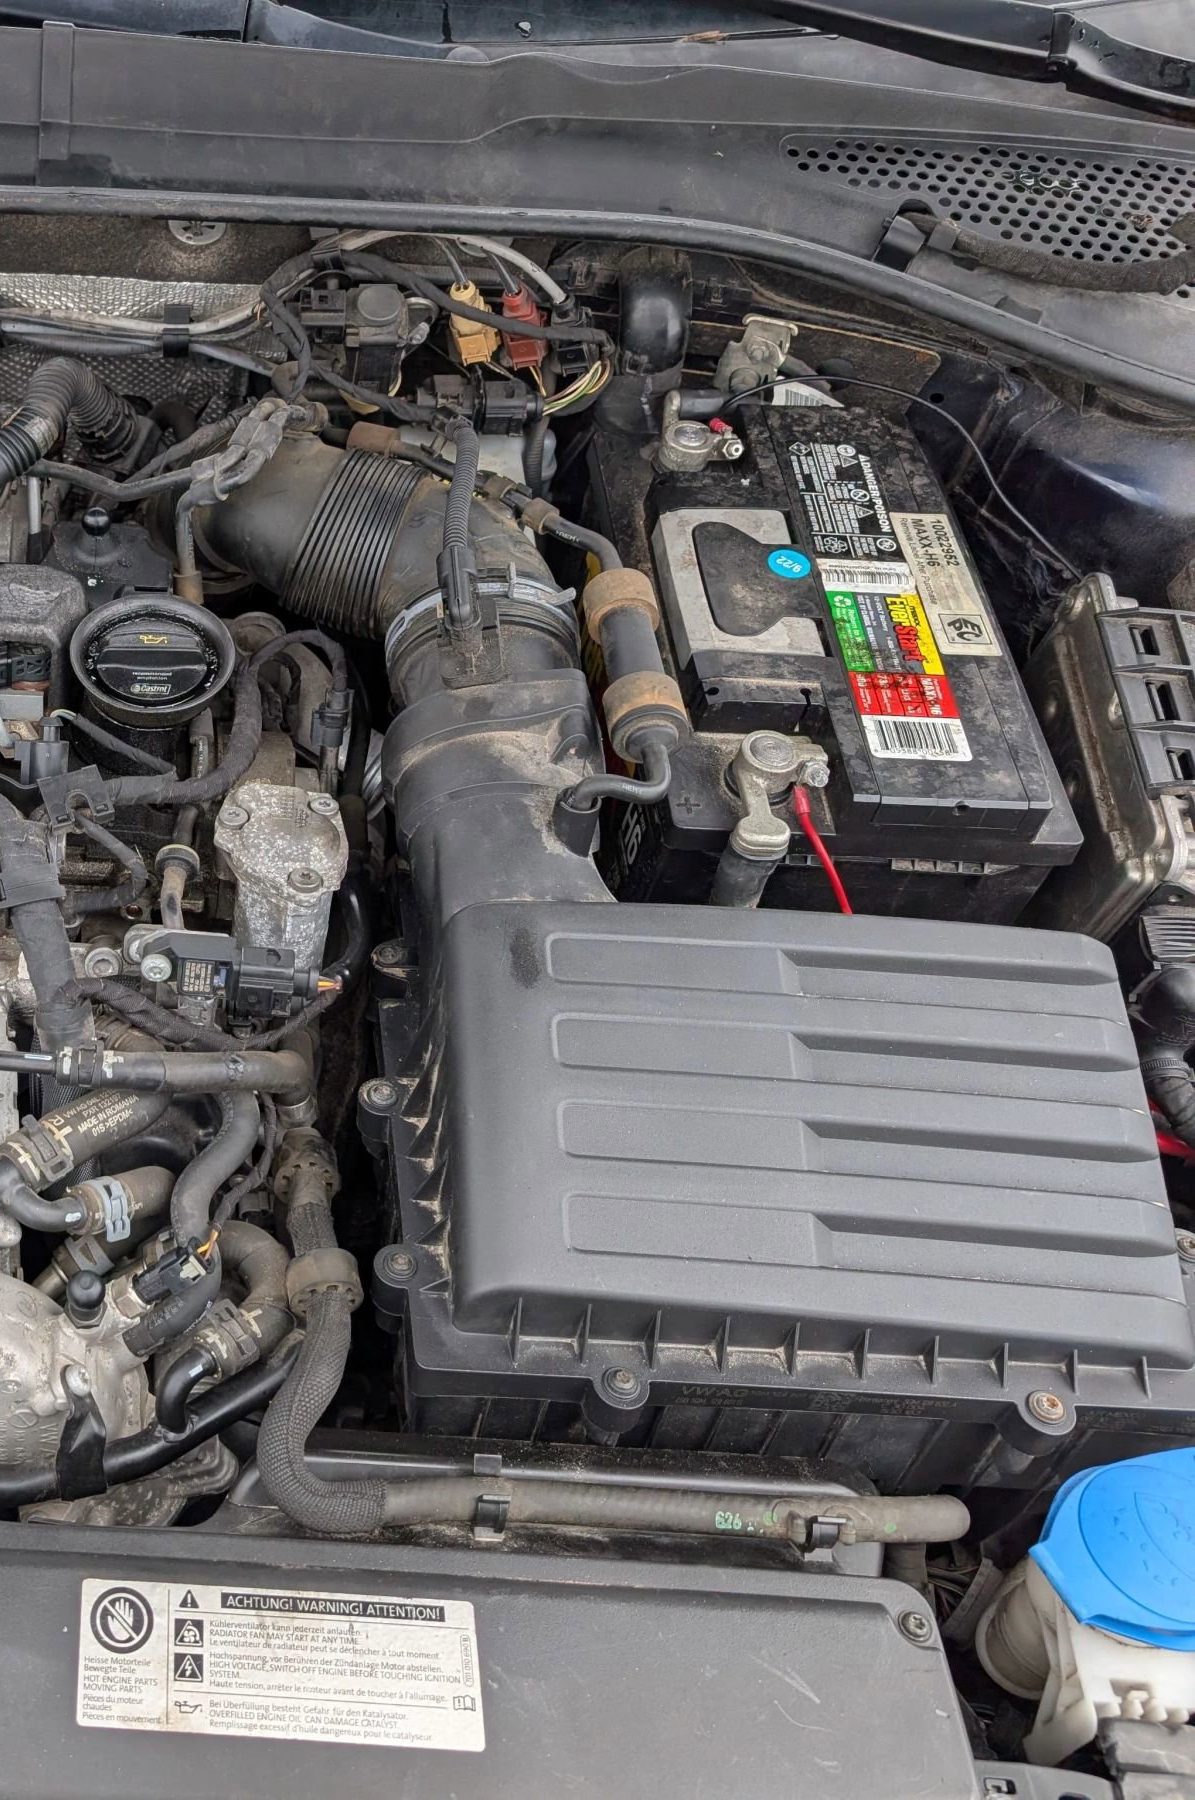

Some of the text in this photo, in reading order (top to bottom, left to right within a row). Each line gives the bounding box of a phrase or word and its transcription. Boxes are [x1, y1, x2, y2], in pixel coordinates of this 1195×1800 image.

[858, 461, 893, 532] DANGER/POISON
[775, 555, 802, 573] 9/22
[898, 517, 939, 604] Remove Label After Purchase
[910, 518, 940, 566] MAXX-H6
[929, 519, 959, 565] 10022952
[883, 597, 927, 661] EverStart
[622, 801, 642, 865] H6
[77, 1094, 140, 1134] MADE IN ROMANIA
[227, 1594, 439, 1620] ACHTUNG! WARNING! ATTENTION!
